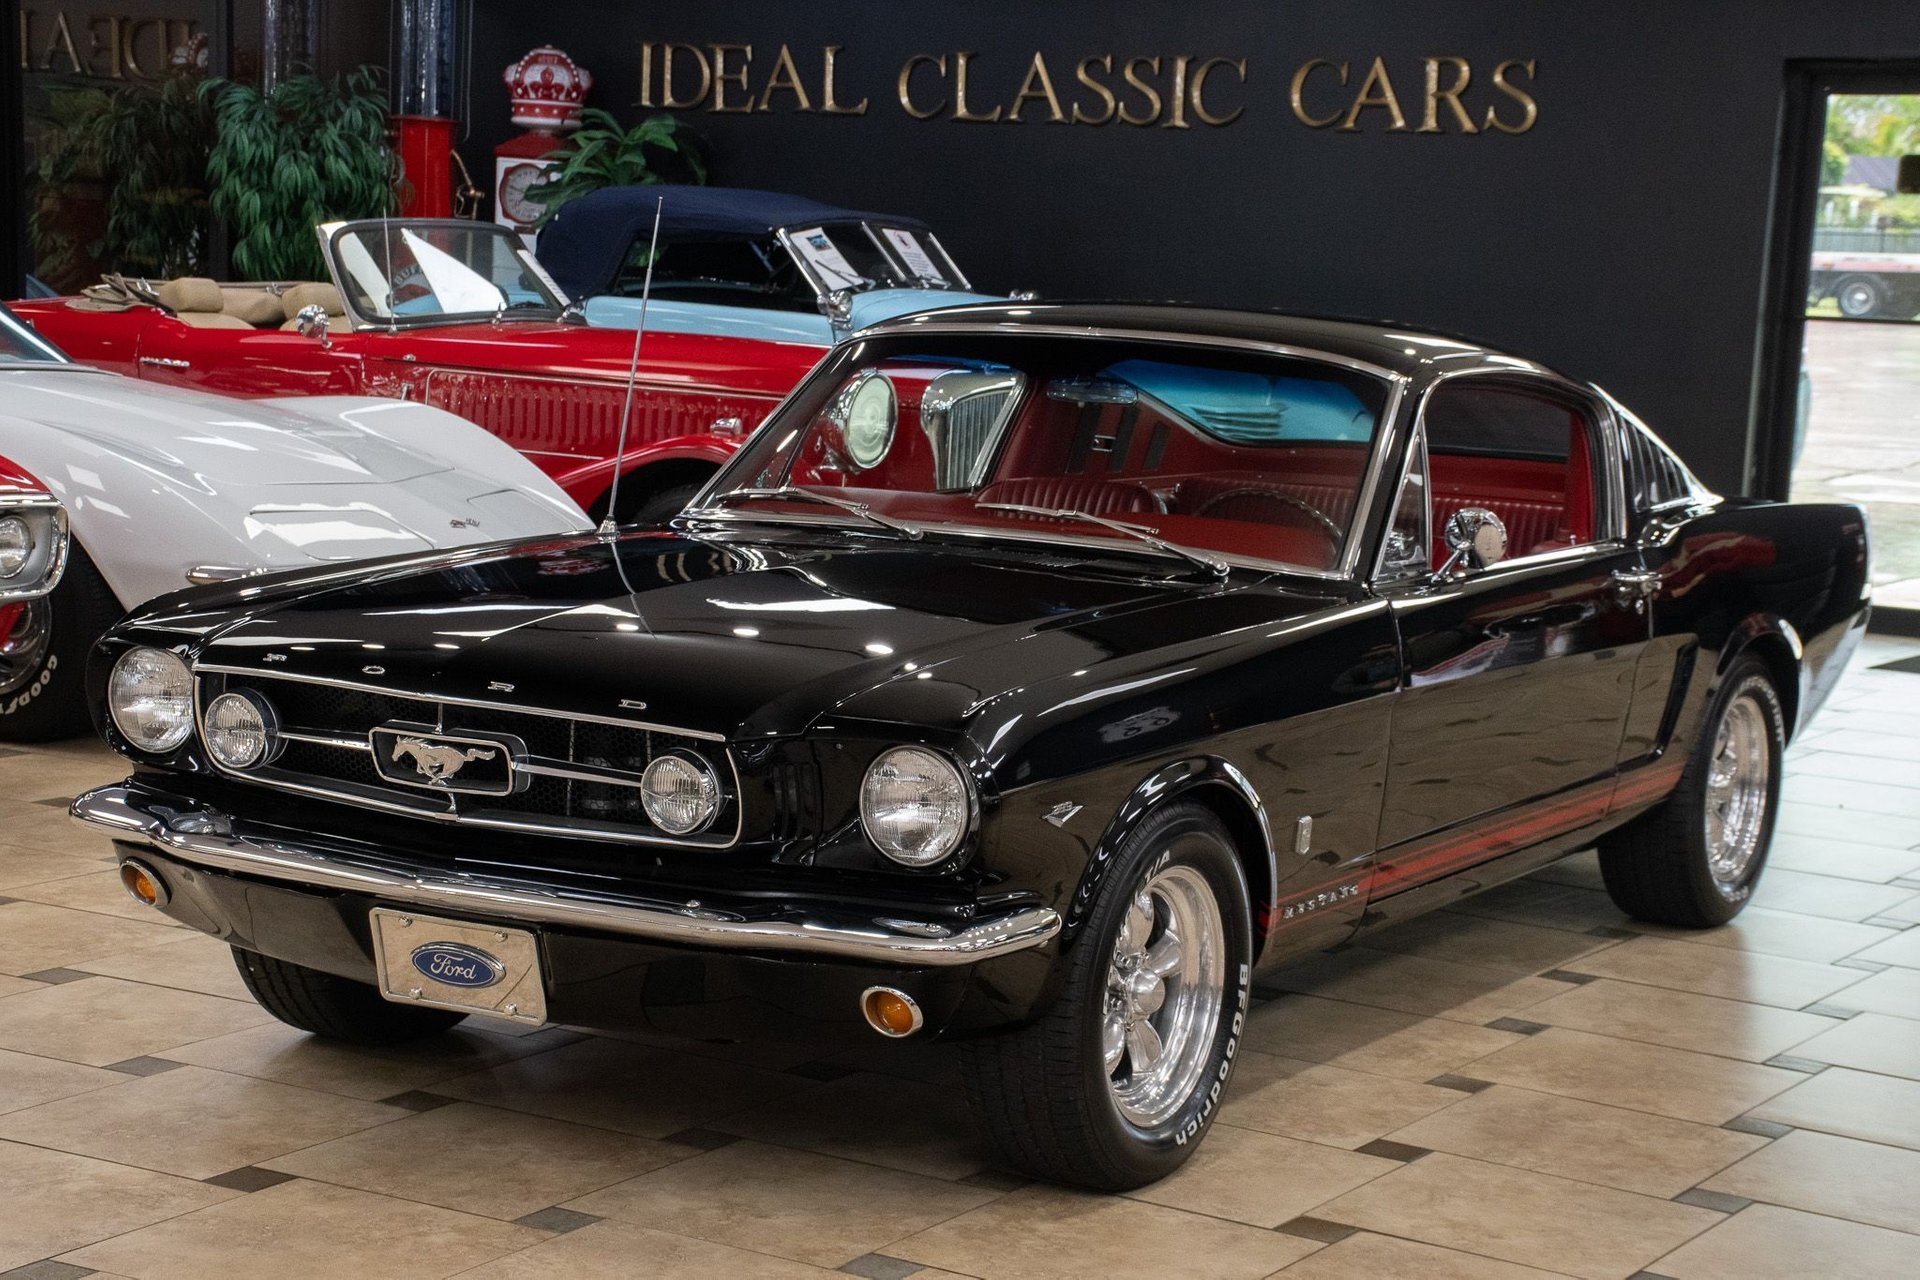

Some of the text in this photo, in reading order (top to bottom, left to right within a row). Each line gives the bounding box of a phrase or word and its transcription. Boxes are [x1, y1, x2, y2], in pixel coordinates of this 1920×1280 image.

[632, 43, 1538, 134] IDEAL CLASSIC CARS
[262, 653, 648, 710] FORD
[430, 953, 477, 980] Ford
[1175, 963, 1249, 1146] BFGoodrich
